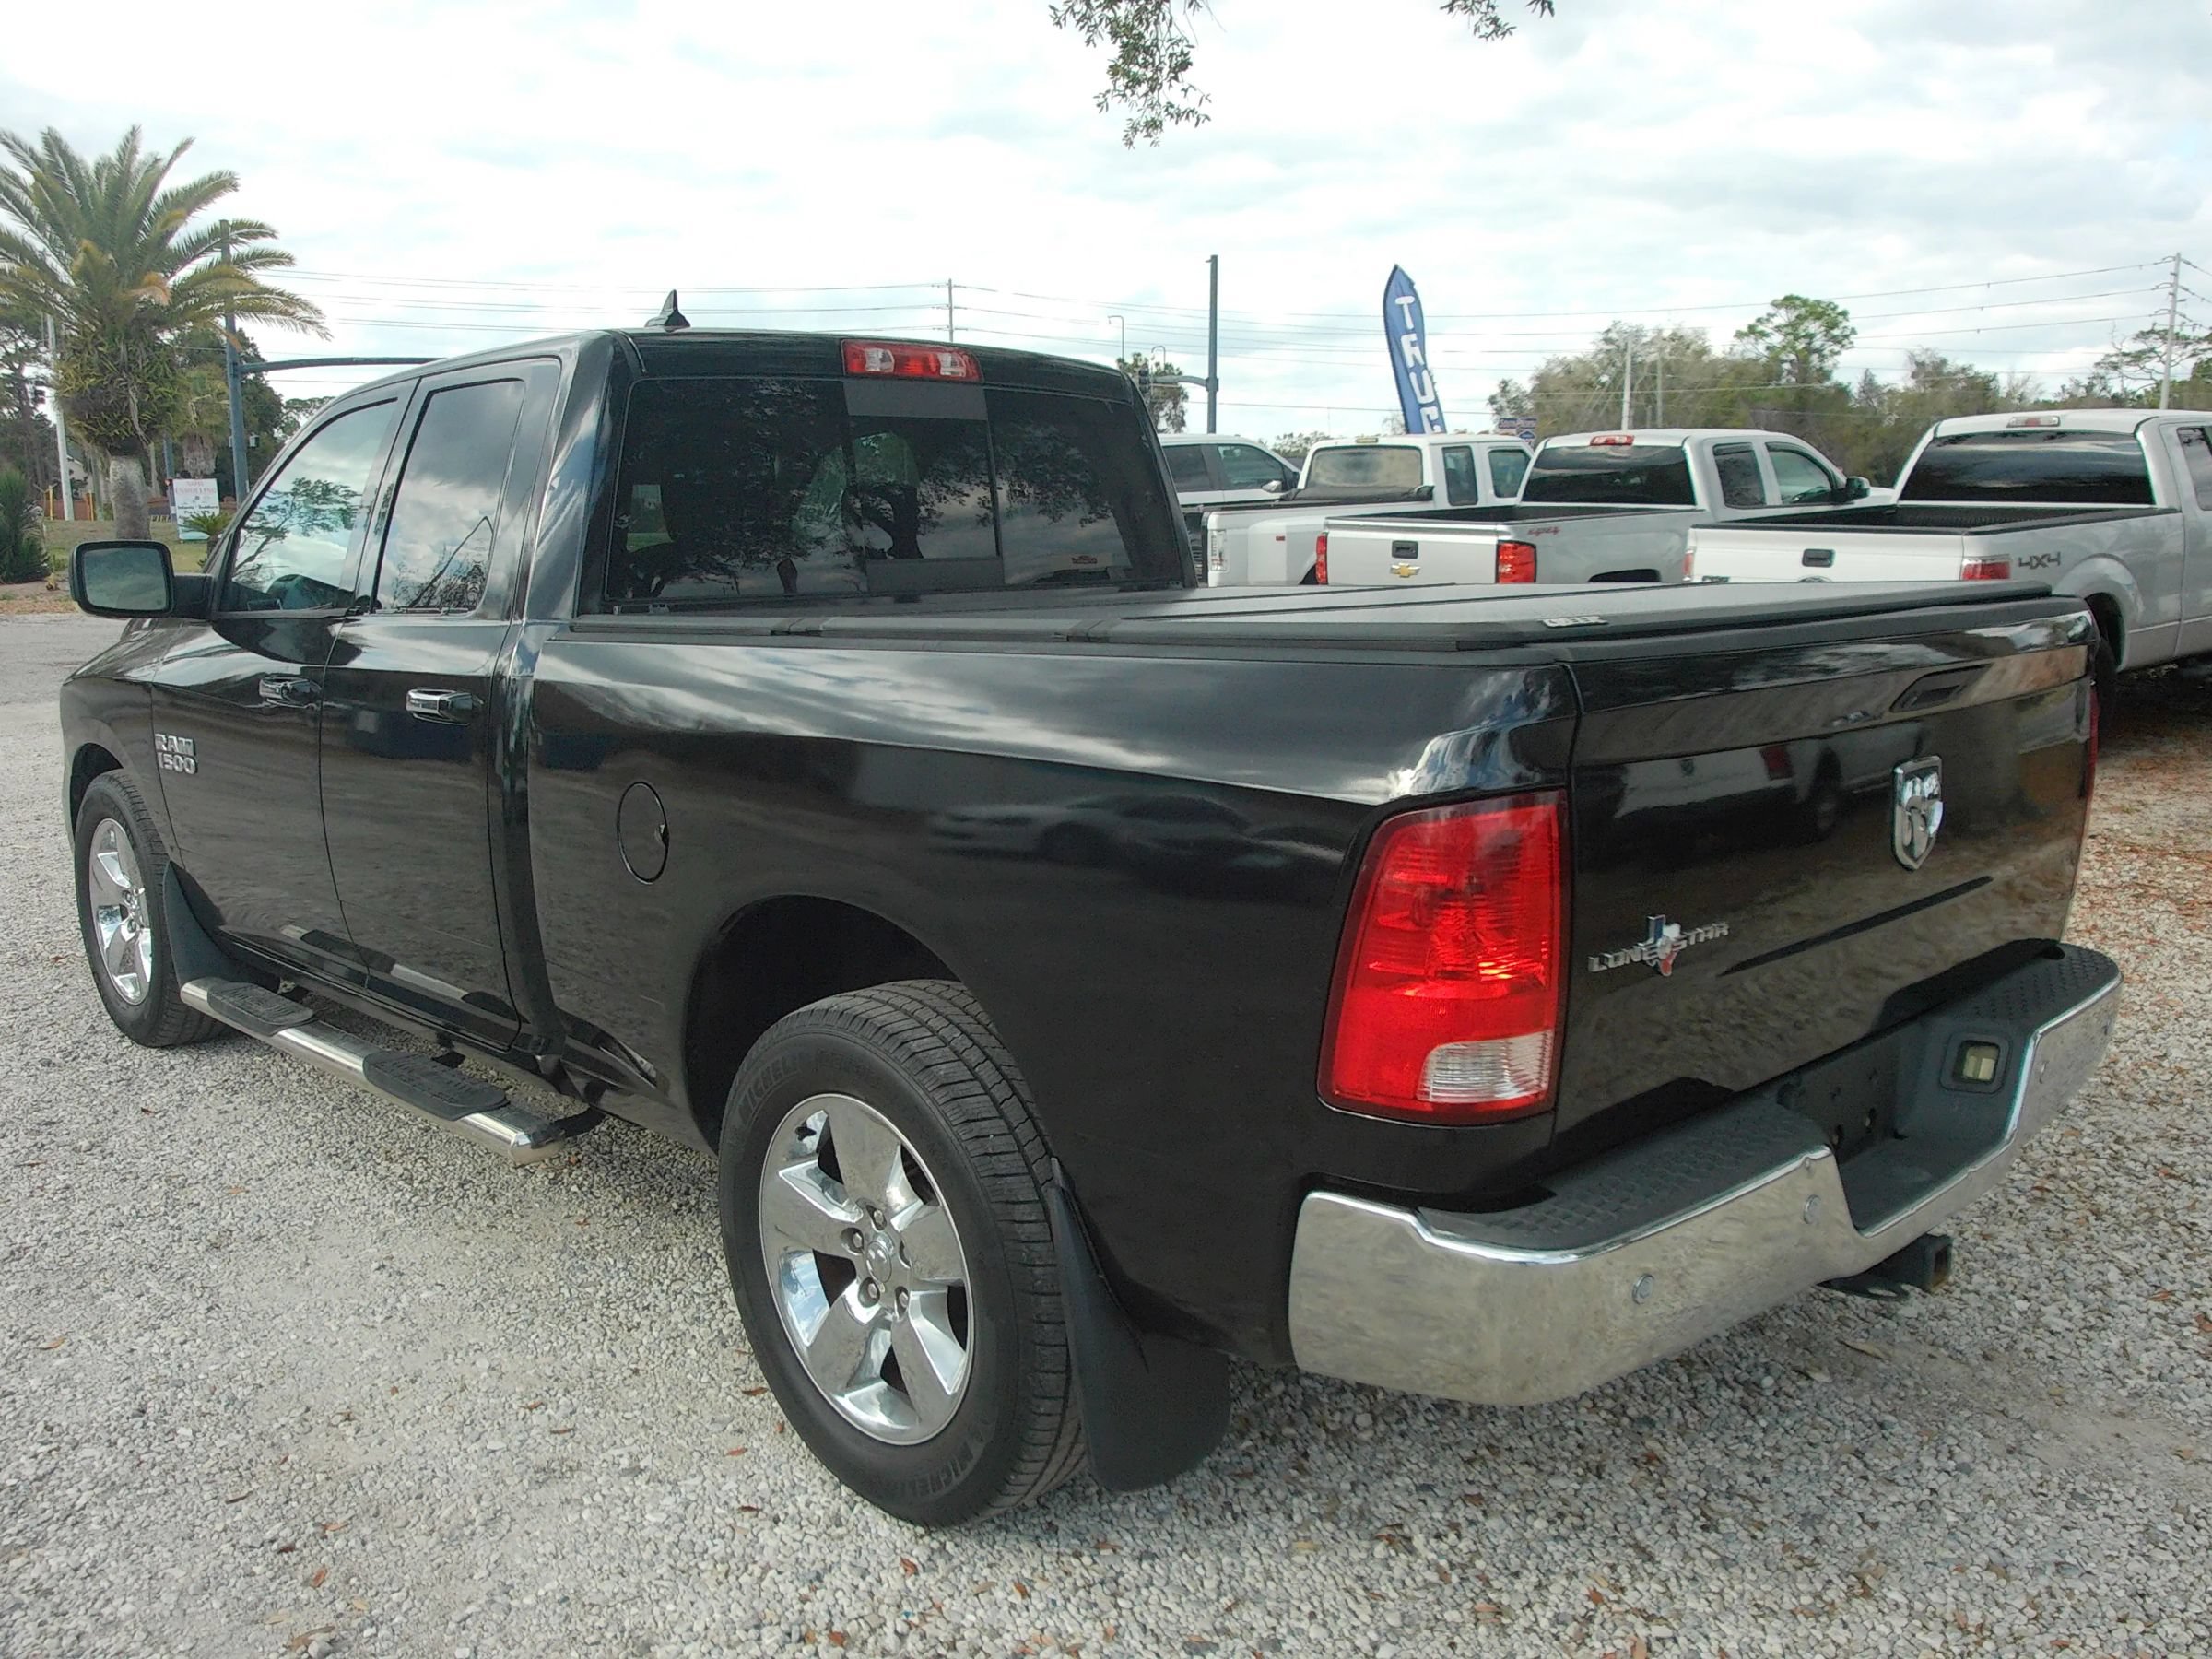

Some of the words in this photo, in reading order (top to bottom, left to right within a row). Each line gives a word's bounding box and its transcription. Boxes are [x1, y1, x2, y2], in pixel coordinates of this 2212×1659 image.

[155, 733, 195, 756] RAM
[157, 751, 197, 775] 1500
[1587, 942, 1661, 972] LONE
